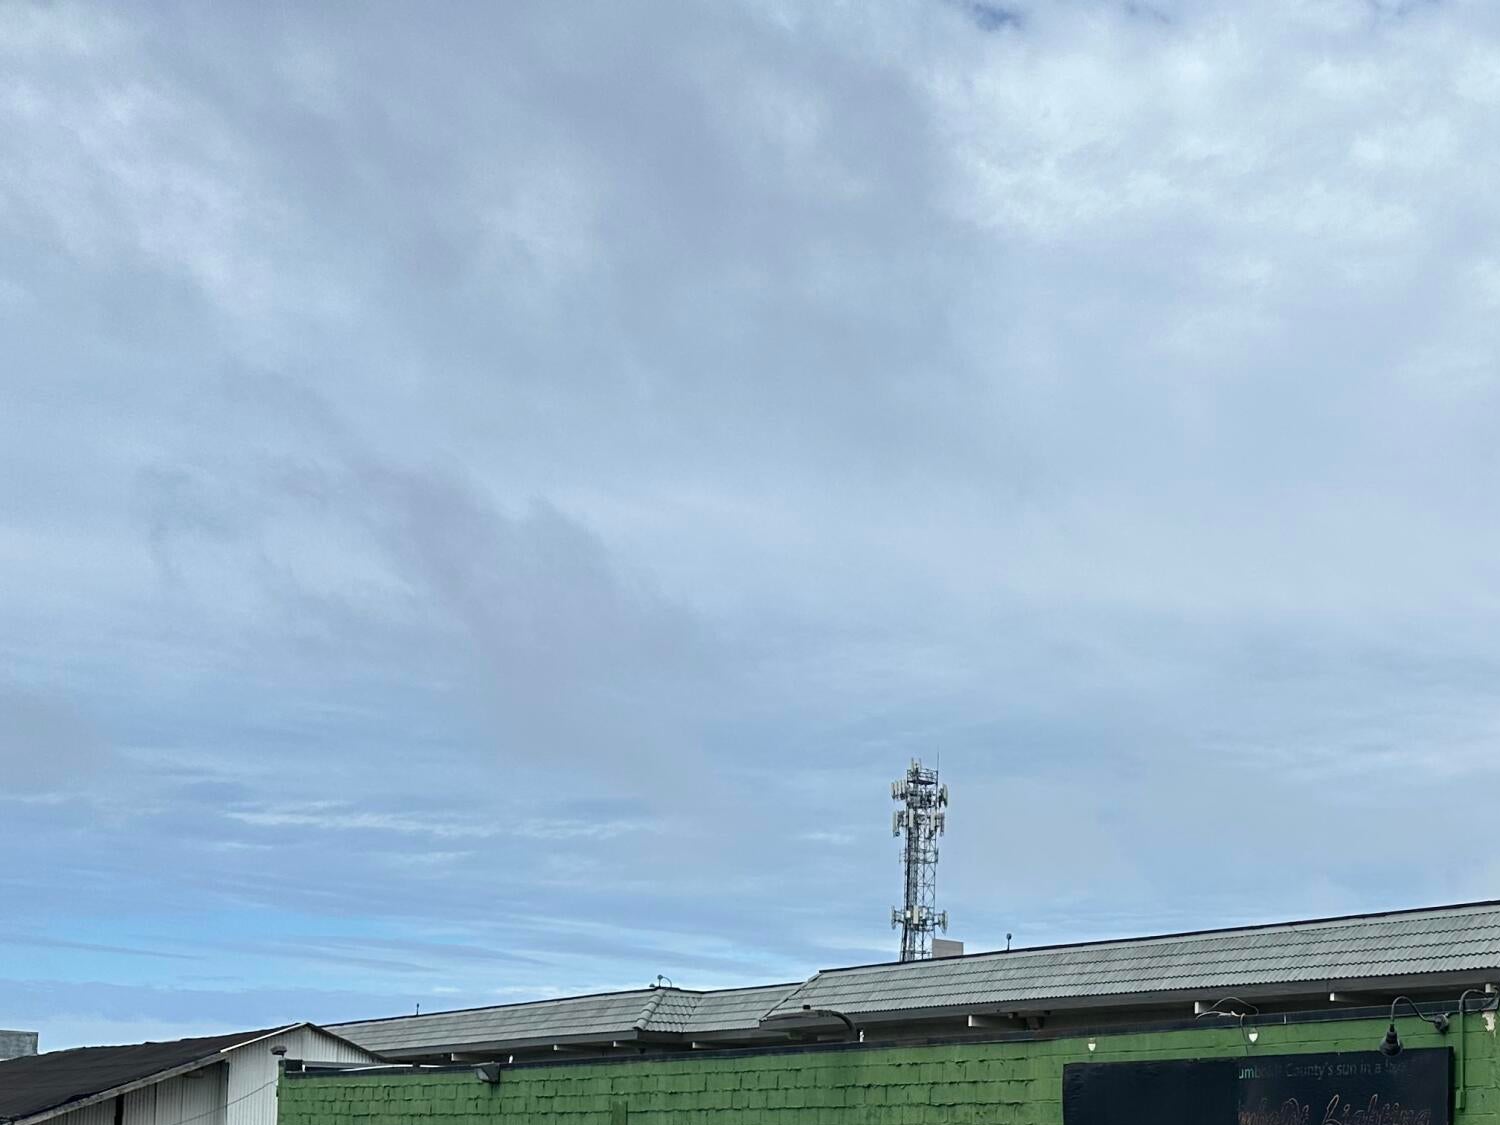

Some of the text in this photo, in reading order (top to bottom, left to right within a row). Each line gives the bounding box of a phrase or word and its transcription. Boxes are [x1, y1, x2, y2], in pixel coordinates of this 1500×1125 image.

[1286, 1061, 1334, 1081] County's
[1336, 1063, 1358, 1076] sun
[1361, 1059, 1373, 1074] in
